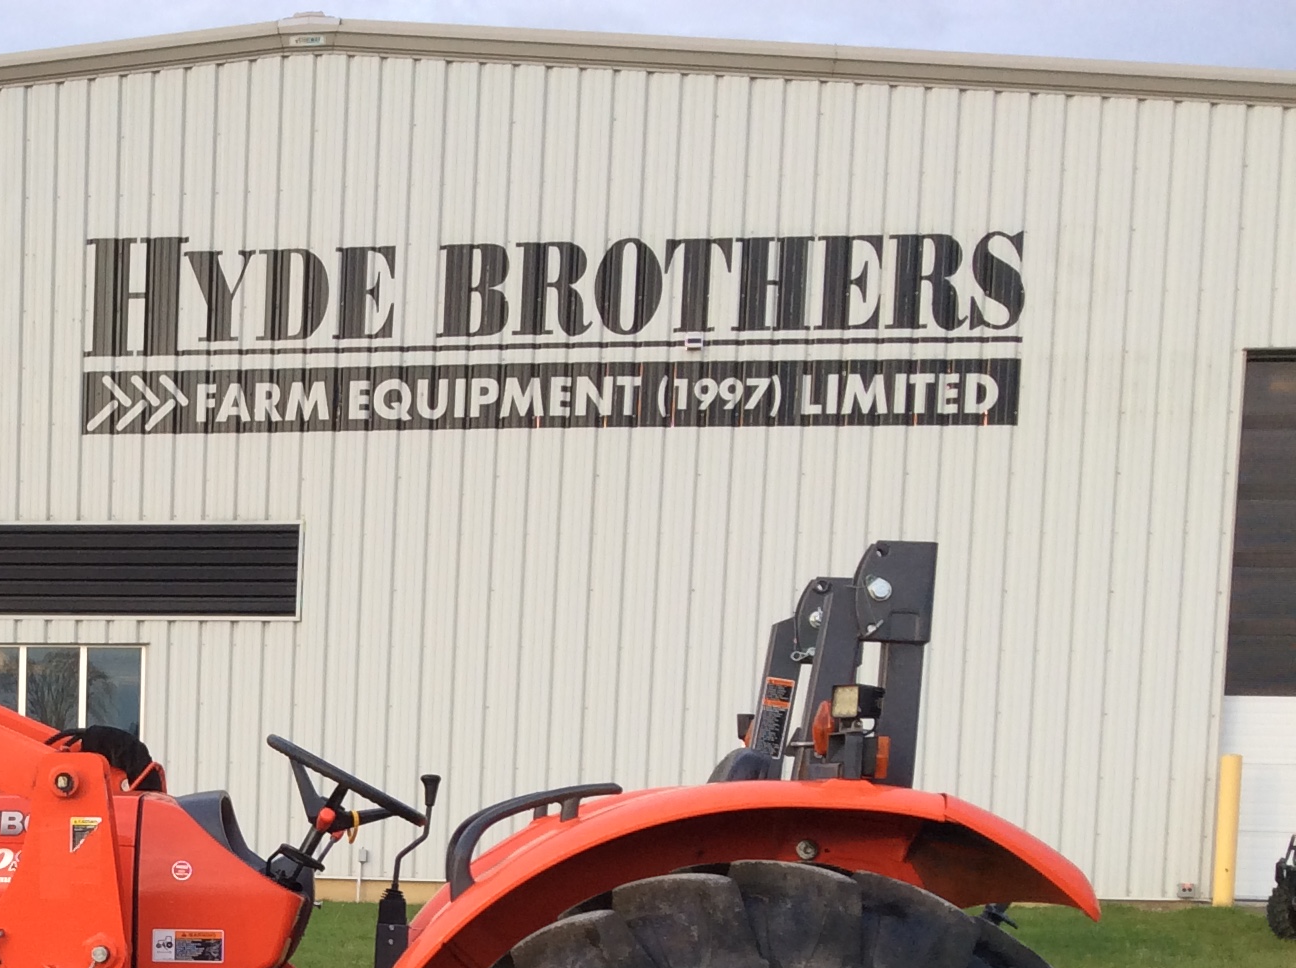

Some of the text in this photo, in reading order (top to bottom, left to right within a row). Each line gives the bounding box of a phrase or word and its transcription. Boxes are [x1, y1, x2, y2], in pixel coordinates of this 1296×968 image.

[84, 231, 1025, 356] HYDE BROTHERS
[196, 373, 999, 422] FARM EQUIPMENT (1997) LIMITED
